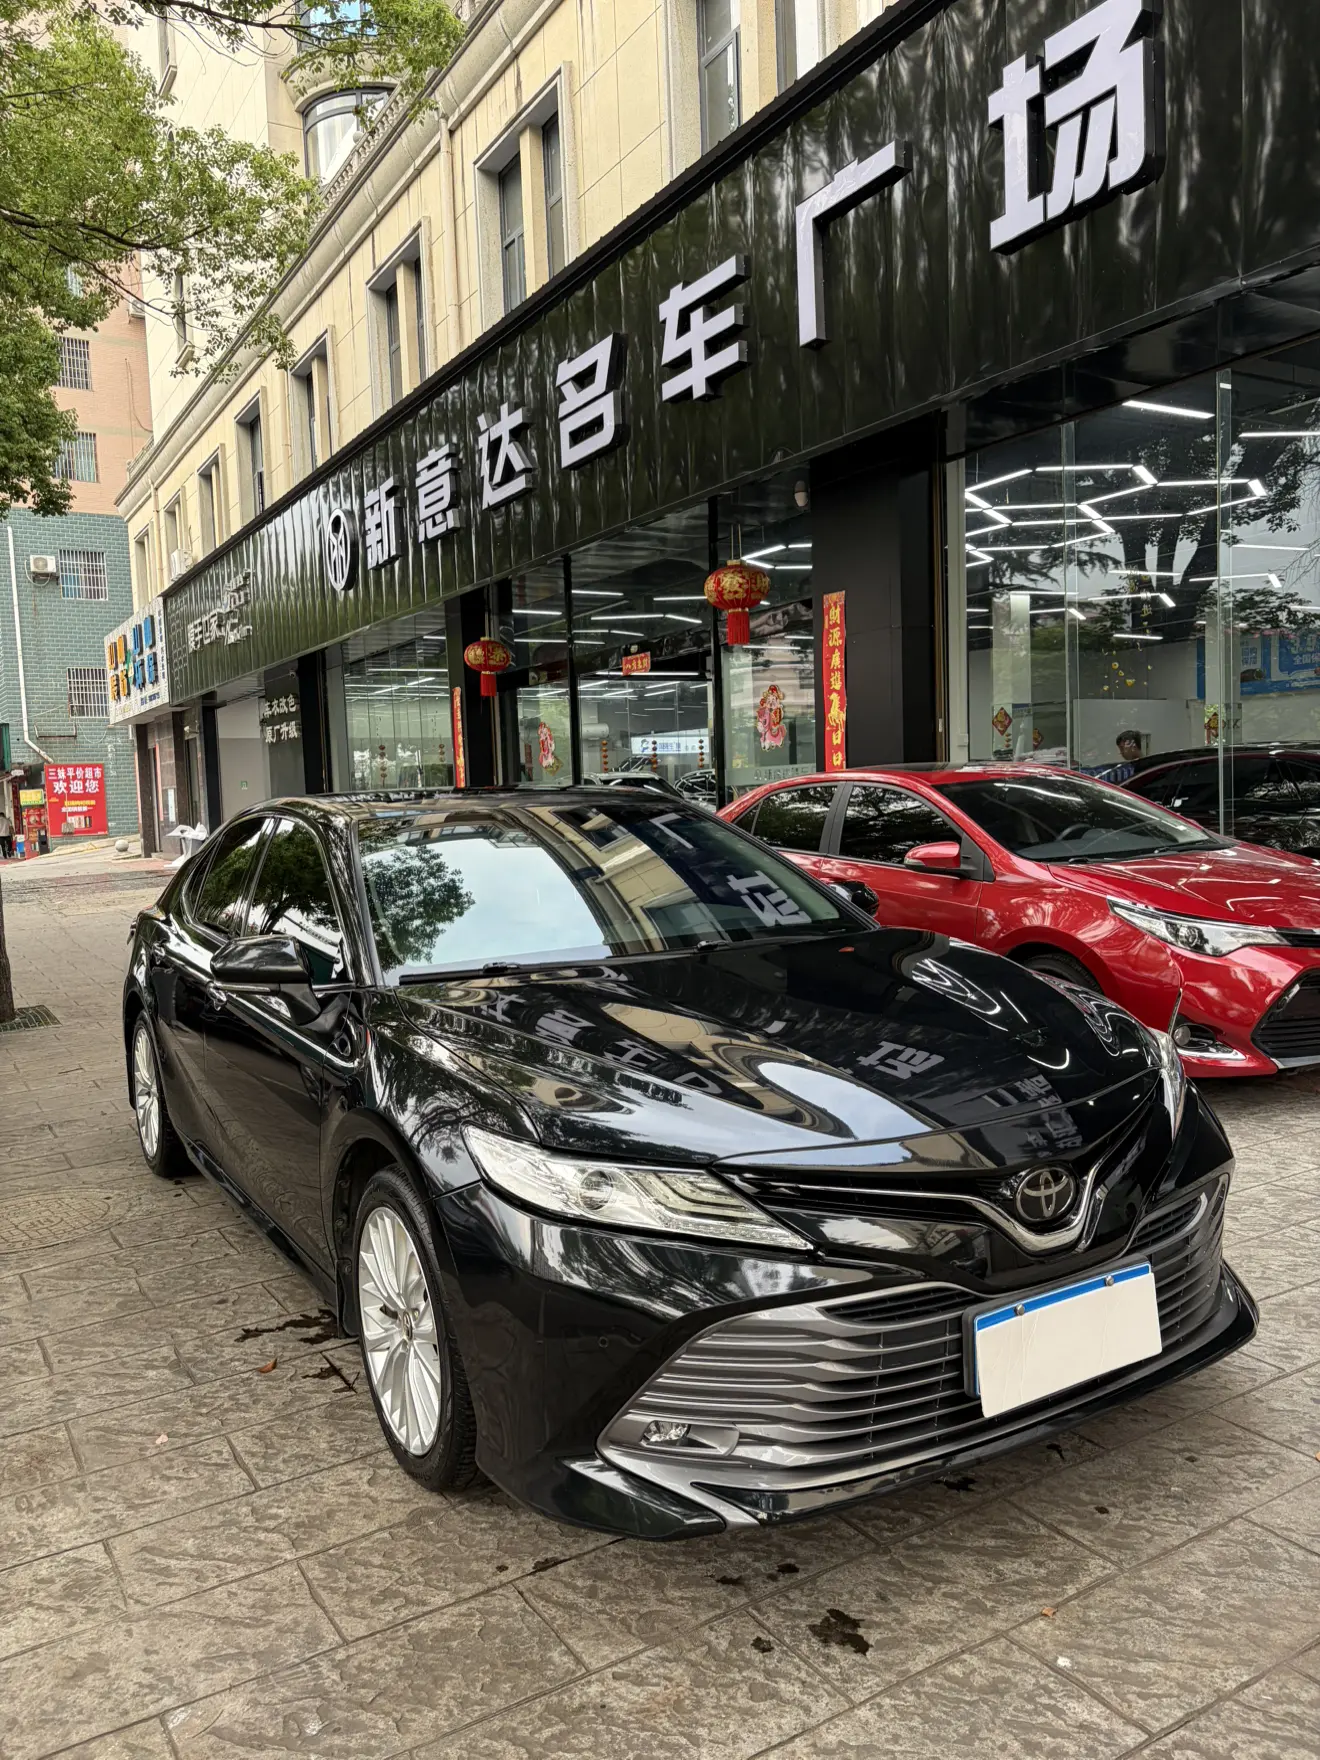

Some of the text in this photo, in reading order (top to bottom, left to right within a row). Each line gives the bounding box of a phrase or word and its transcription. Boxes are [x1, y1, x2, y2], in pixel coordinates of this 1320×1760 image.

[364, 0, 1160, 571] 新意达名车广场
[264, 693, 297, 718] 车衣改色
[265, 720, 298, 743] 原厂升级
[48, 766, 103, 780] 三妹平价超市
[53, 779, 100, 795] 欢迎您
